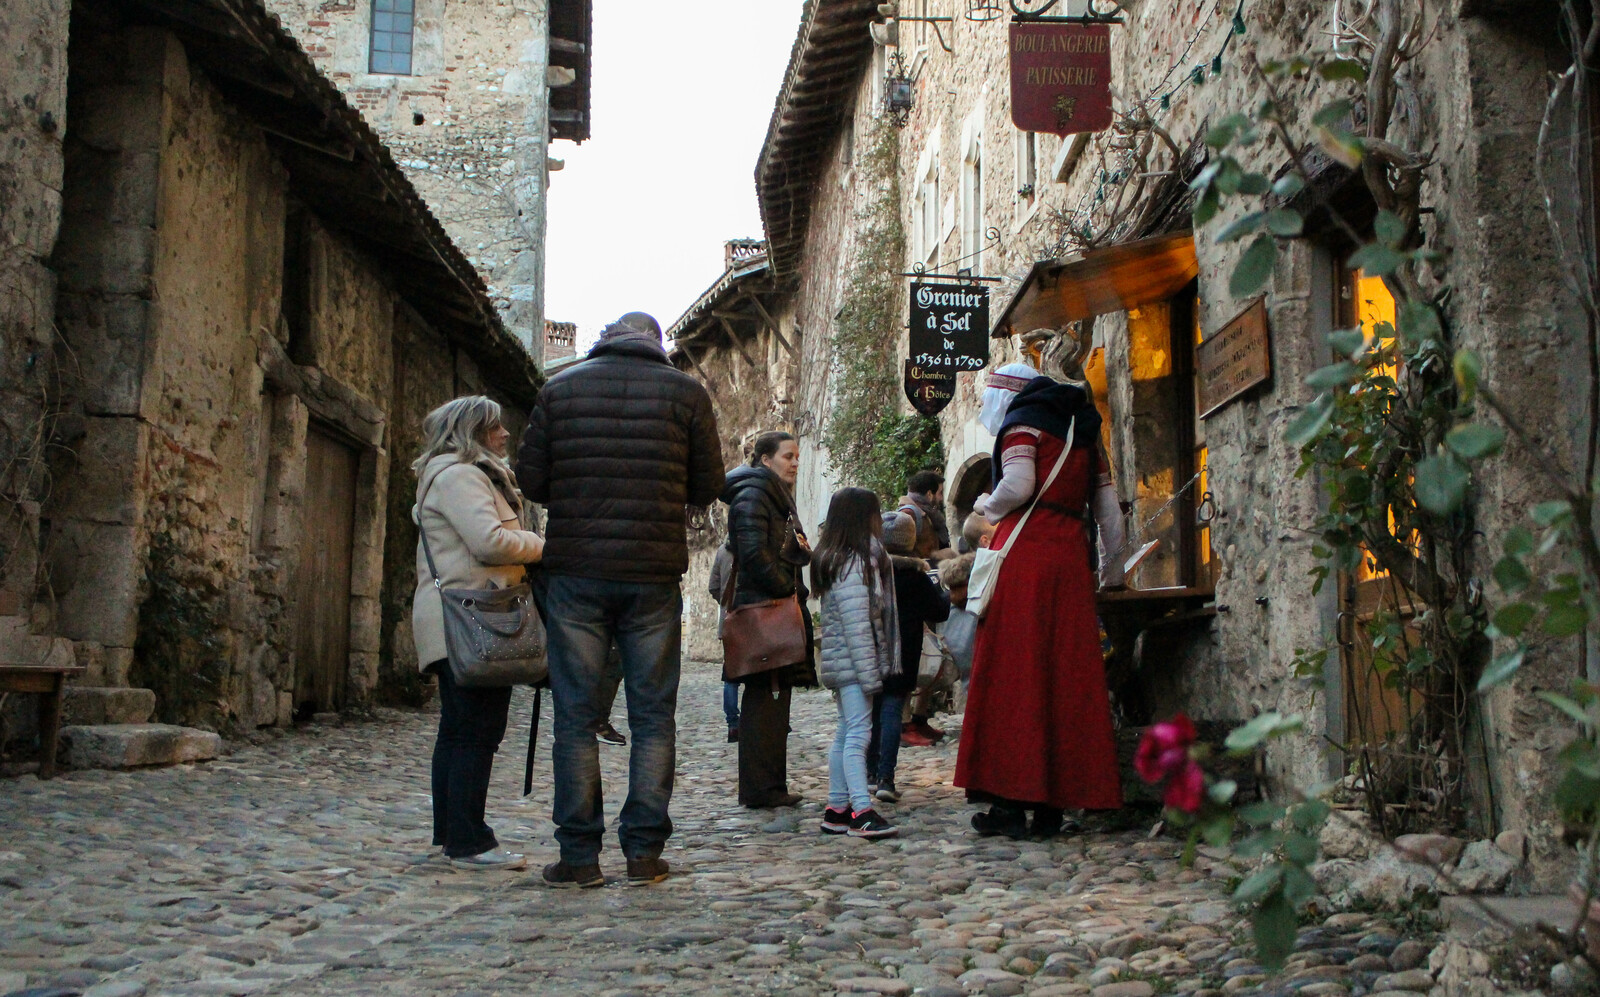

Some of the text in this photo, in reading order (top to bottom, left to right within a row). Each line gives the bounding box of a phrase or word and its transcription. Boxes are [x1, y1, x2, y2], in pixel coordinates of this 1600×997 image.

[1015, 34, 1106, 52] BOULANGERIE
[1026, 67, 1096, 86] PATISSERIE
[916, 286, 982, 308] Grenier
[926, 311, 972, 334] à Sel
[943, 338, 955, 350] de
[915, 352, 983, 369] 1536 à 1790
